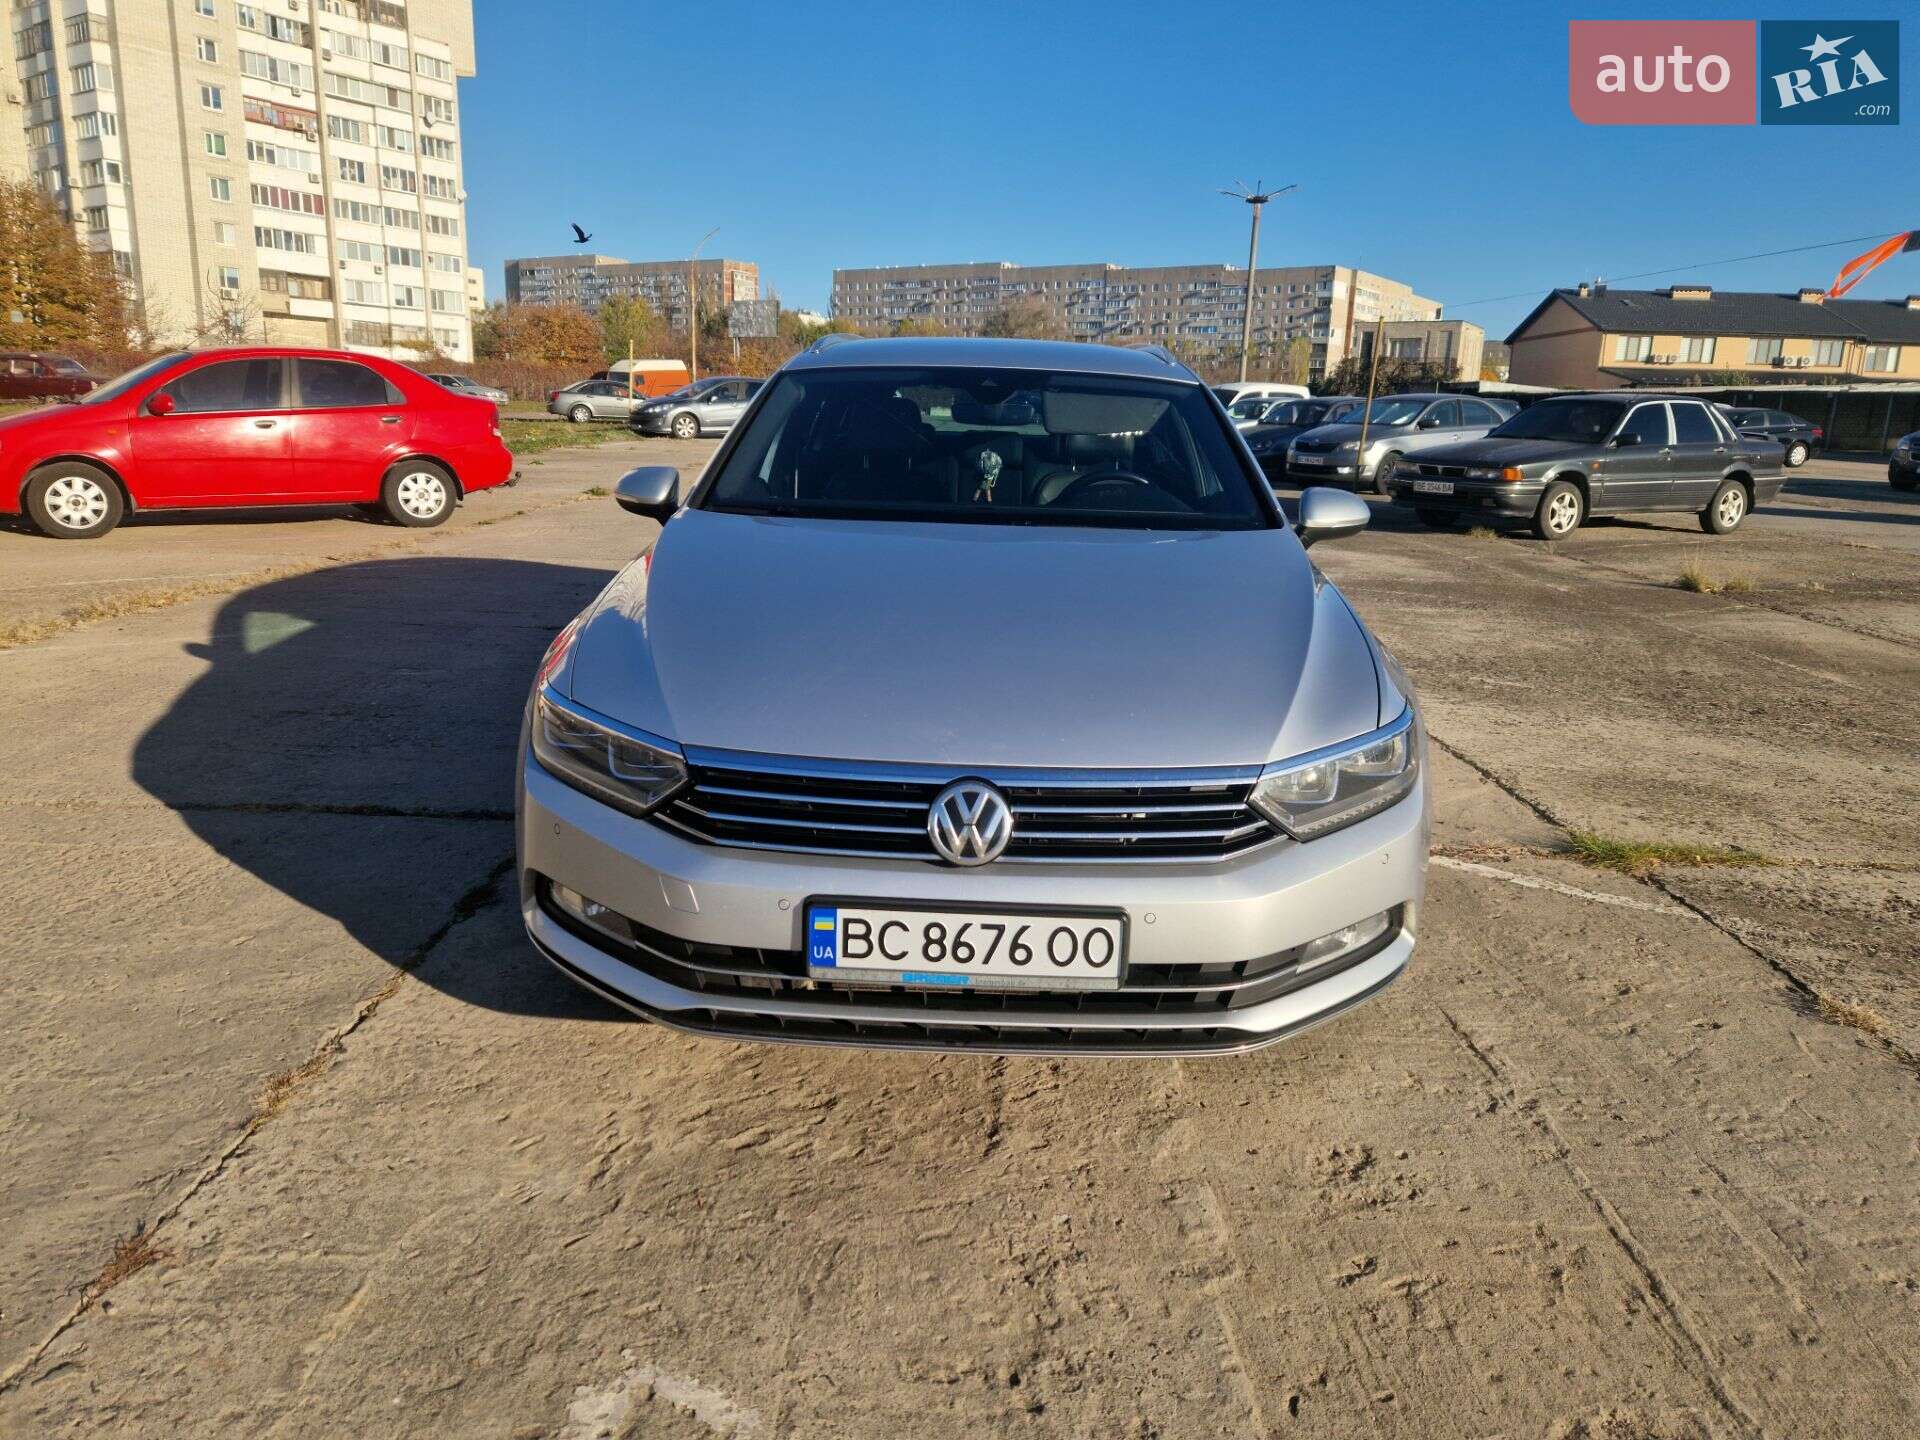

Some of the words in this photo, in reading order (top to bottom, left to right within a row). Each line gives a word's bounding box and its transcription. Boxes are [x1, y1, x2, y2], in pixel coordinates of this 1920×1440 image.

[814, 945, 834, 960] UA
[841, 917, 910, 961] BC
[921, 921, 1034, 966] 8676
